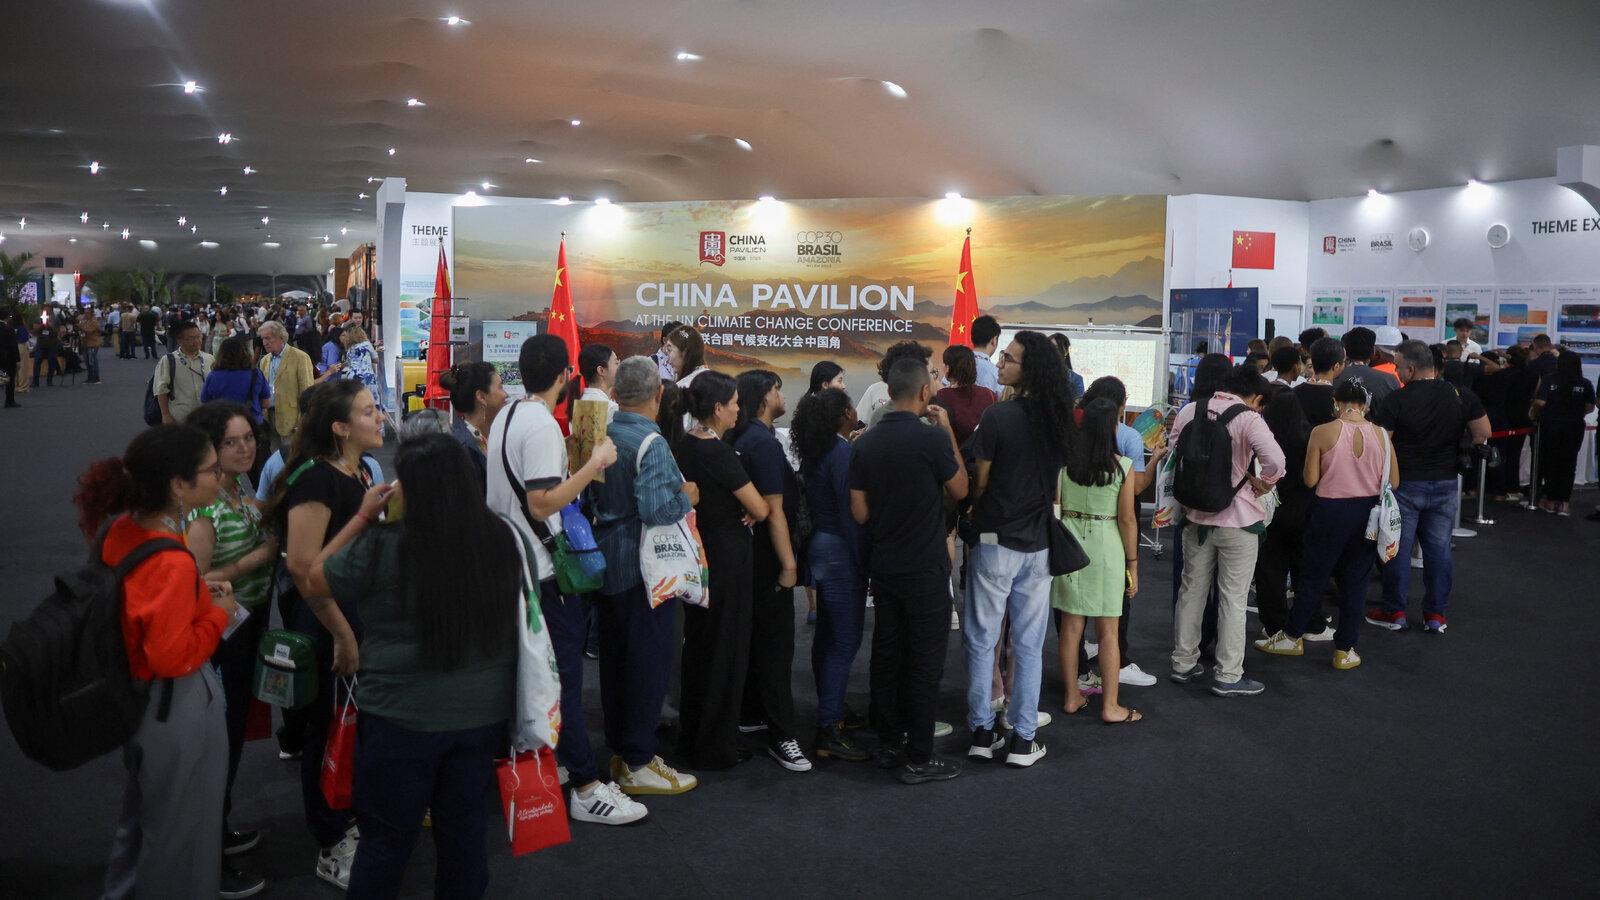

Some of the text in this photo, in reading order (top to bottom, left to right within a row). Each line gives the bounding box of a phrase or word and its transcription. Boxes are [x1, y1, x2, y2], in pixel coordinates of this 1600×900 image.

[411, 224, 449, 236] THEME
[1531, 219, 1578, 234] THEME
[729, 234, 766, 245] CHINA
[797, 230, 843, 244] COP30
[1337, 236, 1357, 244] CHINA
[797, 244, 842, 256] BRASIL
[635, 282, 915, 312] CHINA PAVILION
[634, 314, 649, 326] AT
[697, 314, 751, 329] CLIMATE
[754, 316, 814, 330] CHANGE
[817, 317, 913, 333] CONFERENCE
[700, 332, 841, 350] 联合国气候变化大会中国角
[654, 543, 685, 553] BRASIL
